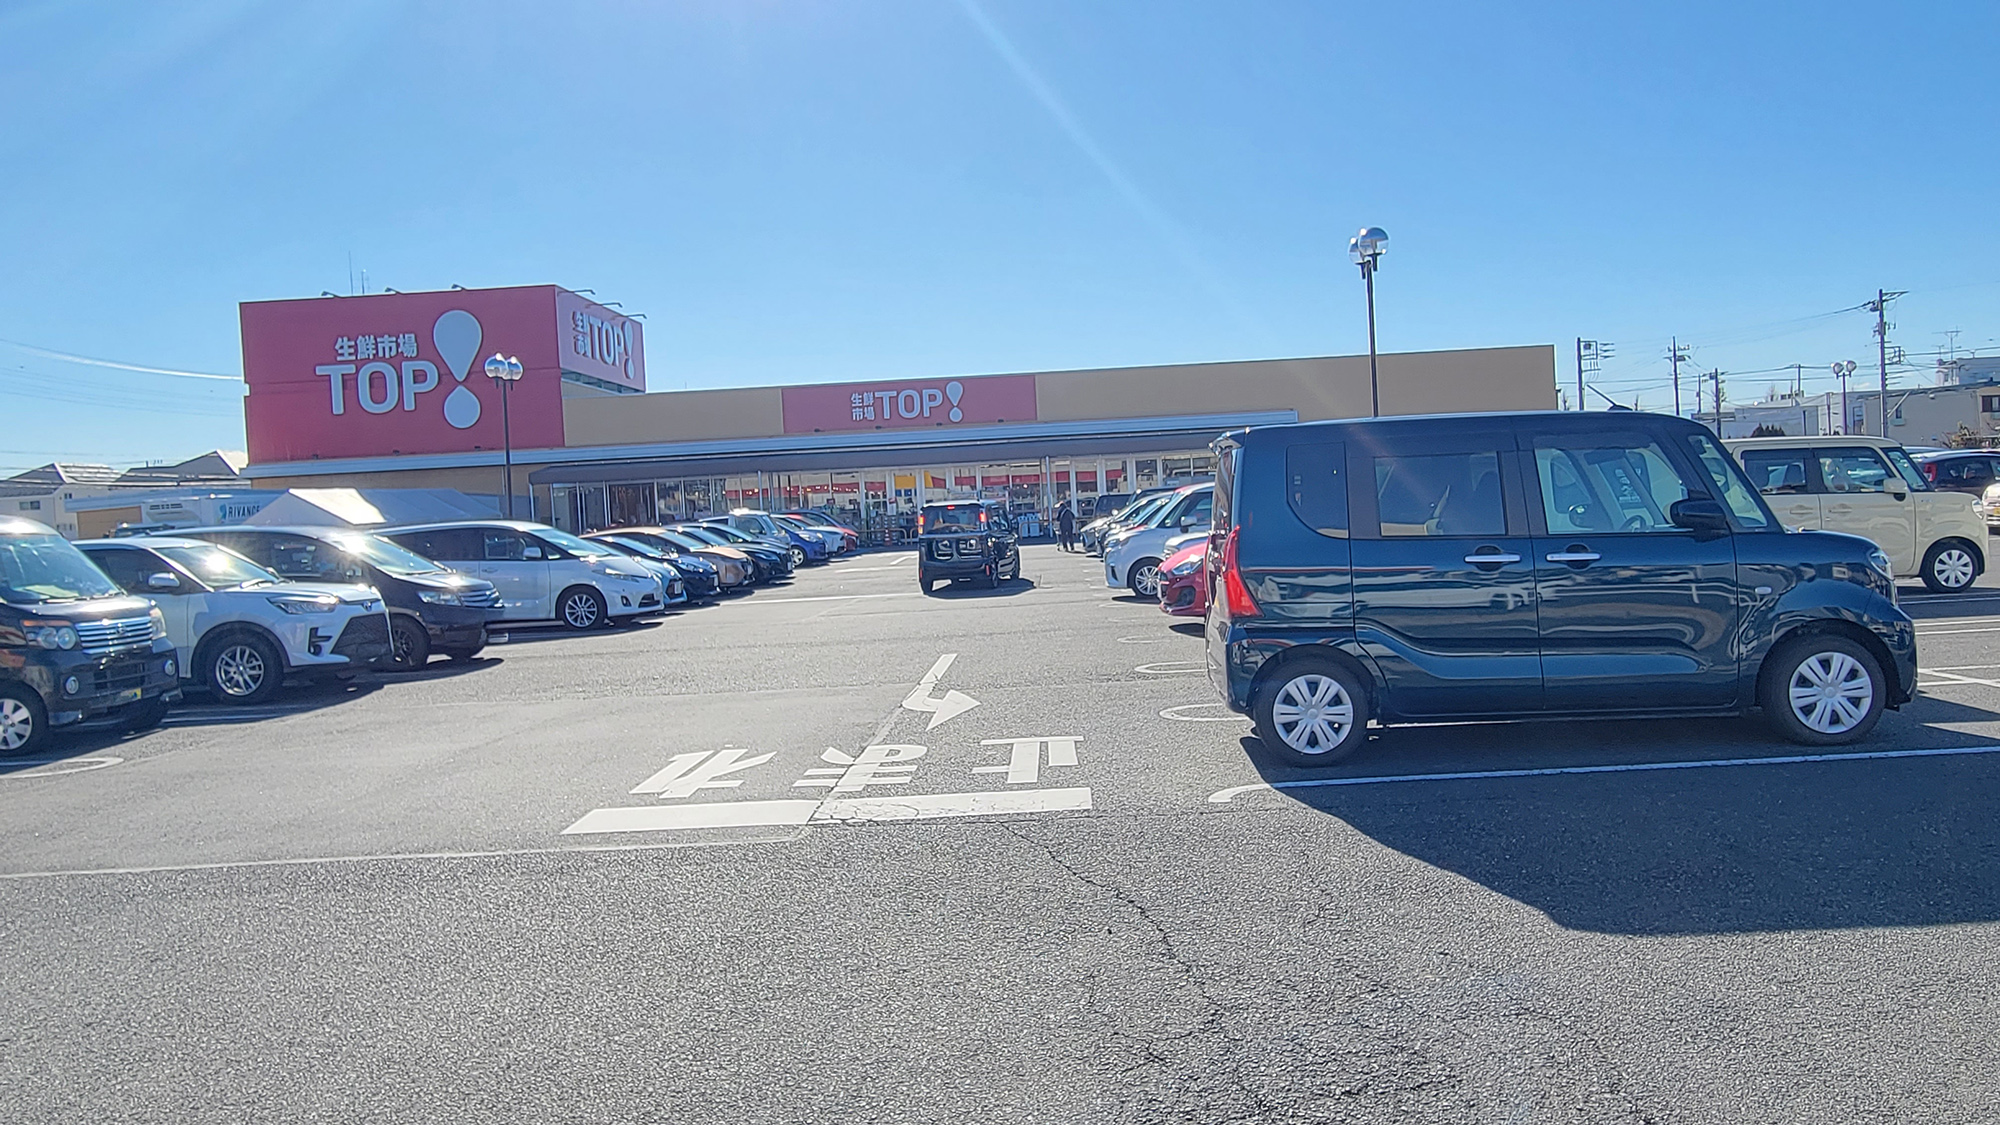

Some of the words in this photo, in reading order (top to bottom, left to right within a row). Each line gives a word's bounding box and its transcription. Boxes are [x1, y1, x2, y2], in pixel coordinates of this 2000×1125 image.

[335, 333, 418, 361] 生鮮市場
[629, 735, 1085, 799] 止まれ
